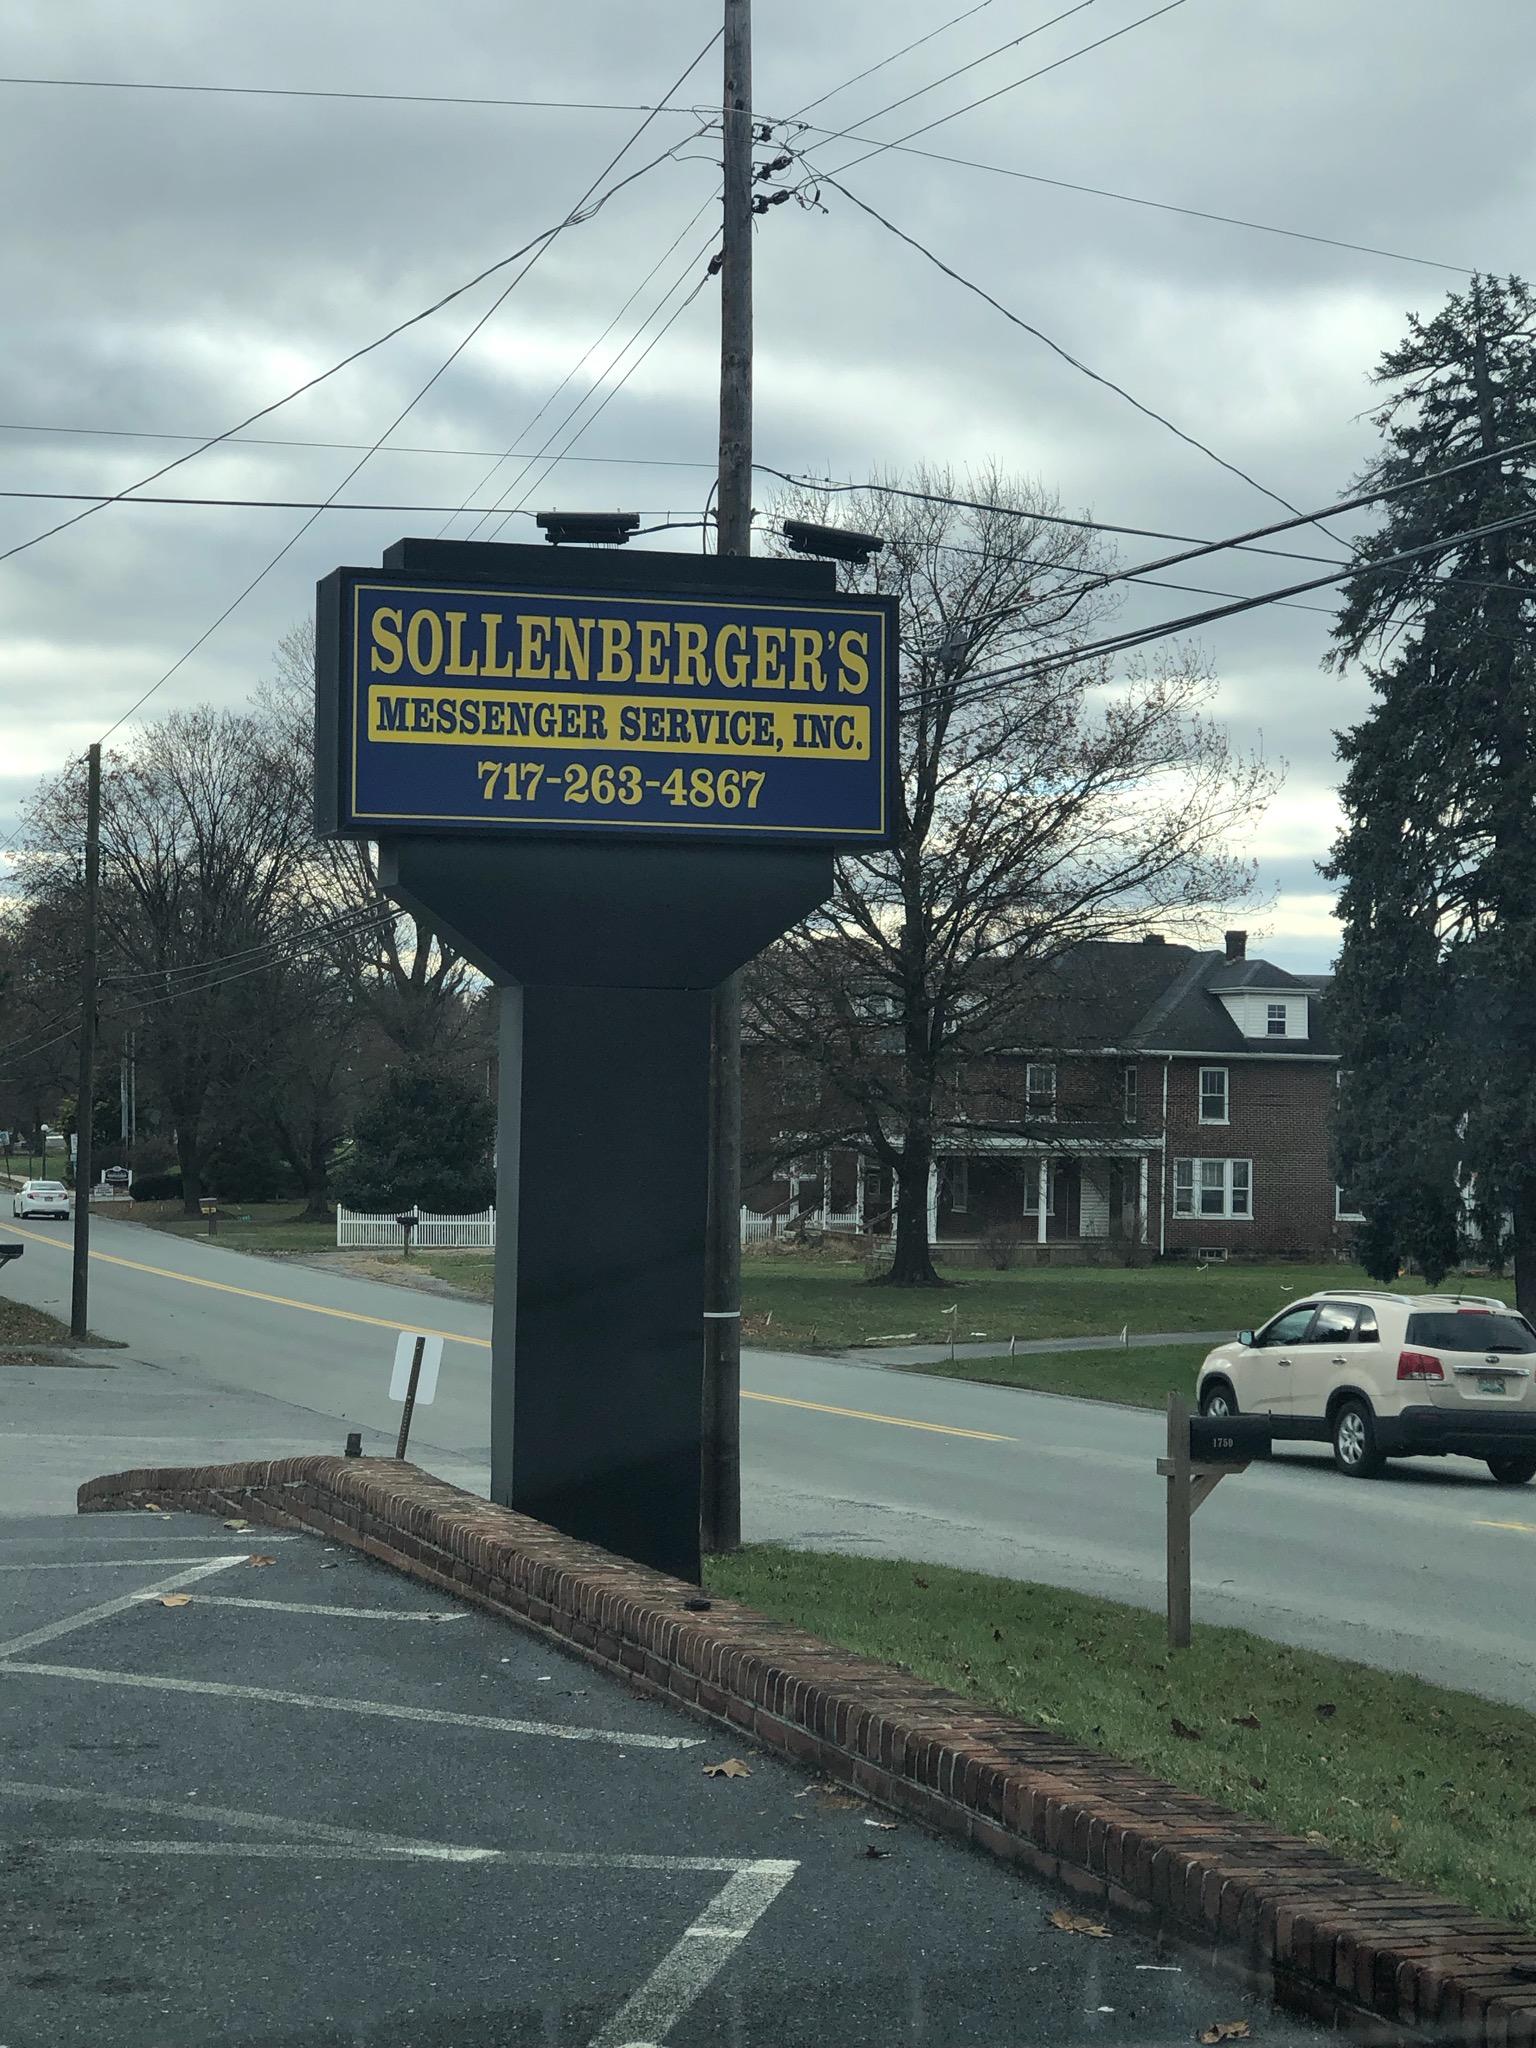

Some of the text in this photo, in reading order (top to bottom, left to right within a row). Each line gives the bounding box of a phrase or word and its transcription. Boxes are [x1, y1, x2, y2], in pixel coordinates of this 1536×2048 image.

[371, 607, 869, 694] SOLLENBERGER'S
[376, 697, 863, 752] MESSENGER SERVICE, INC.
[477, 761, 766, 809] 717-263-4867
